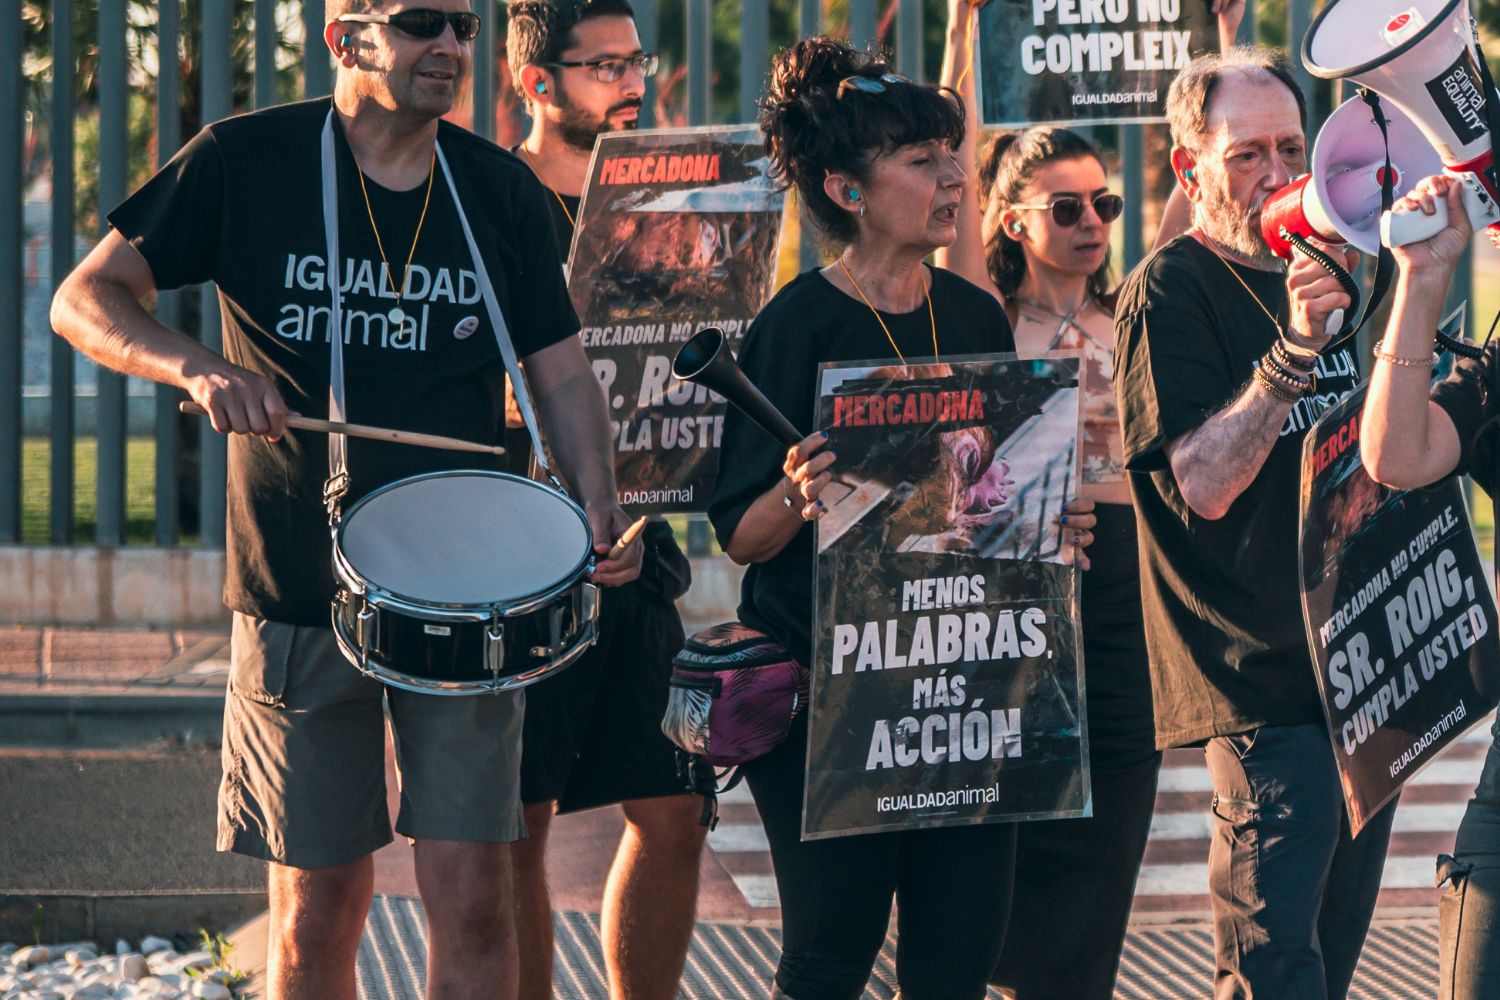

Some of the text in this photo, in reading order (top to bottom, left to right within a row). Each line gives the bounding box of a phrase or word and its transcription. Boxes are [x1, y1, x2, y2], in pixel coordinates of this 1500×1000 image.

[1033, 0, 1129, 26] PERO
[1021, 31, 1192, 75] COMPLEIX
[1442, 75, 1486, 130] EQUALITY
[1453, 66, 1487, 111] animal
[599, 154, 720, 185] MERCADONA
[284, 253, 483, 306] IGUALDAD
[276, 296, 430, 351] animal
[579, 326, 665, 348] ERCADONA
[669, 322, 694, 342] NO
[833, 389, 985, 428] MERCADONA
[902, 574, 986, 612] MENOS
[1319, 506, 1459, 649] MERCADONA NO CUMPLE.
[832, 607, 1053, 675] PALABRAS,
[1328, 548, 1477, 710] SR. ROIG,
[913, 669, 966, 709] MÁS
[1342, 602, 1489, 757] CUMPLA USTED
[865, 699, 1022, 770] ACCIÓN
[1389, 699, 1467, 779] IGUALDADanimal
[877, 783, 999, 812] IGUALDADanimal
